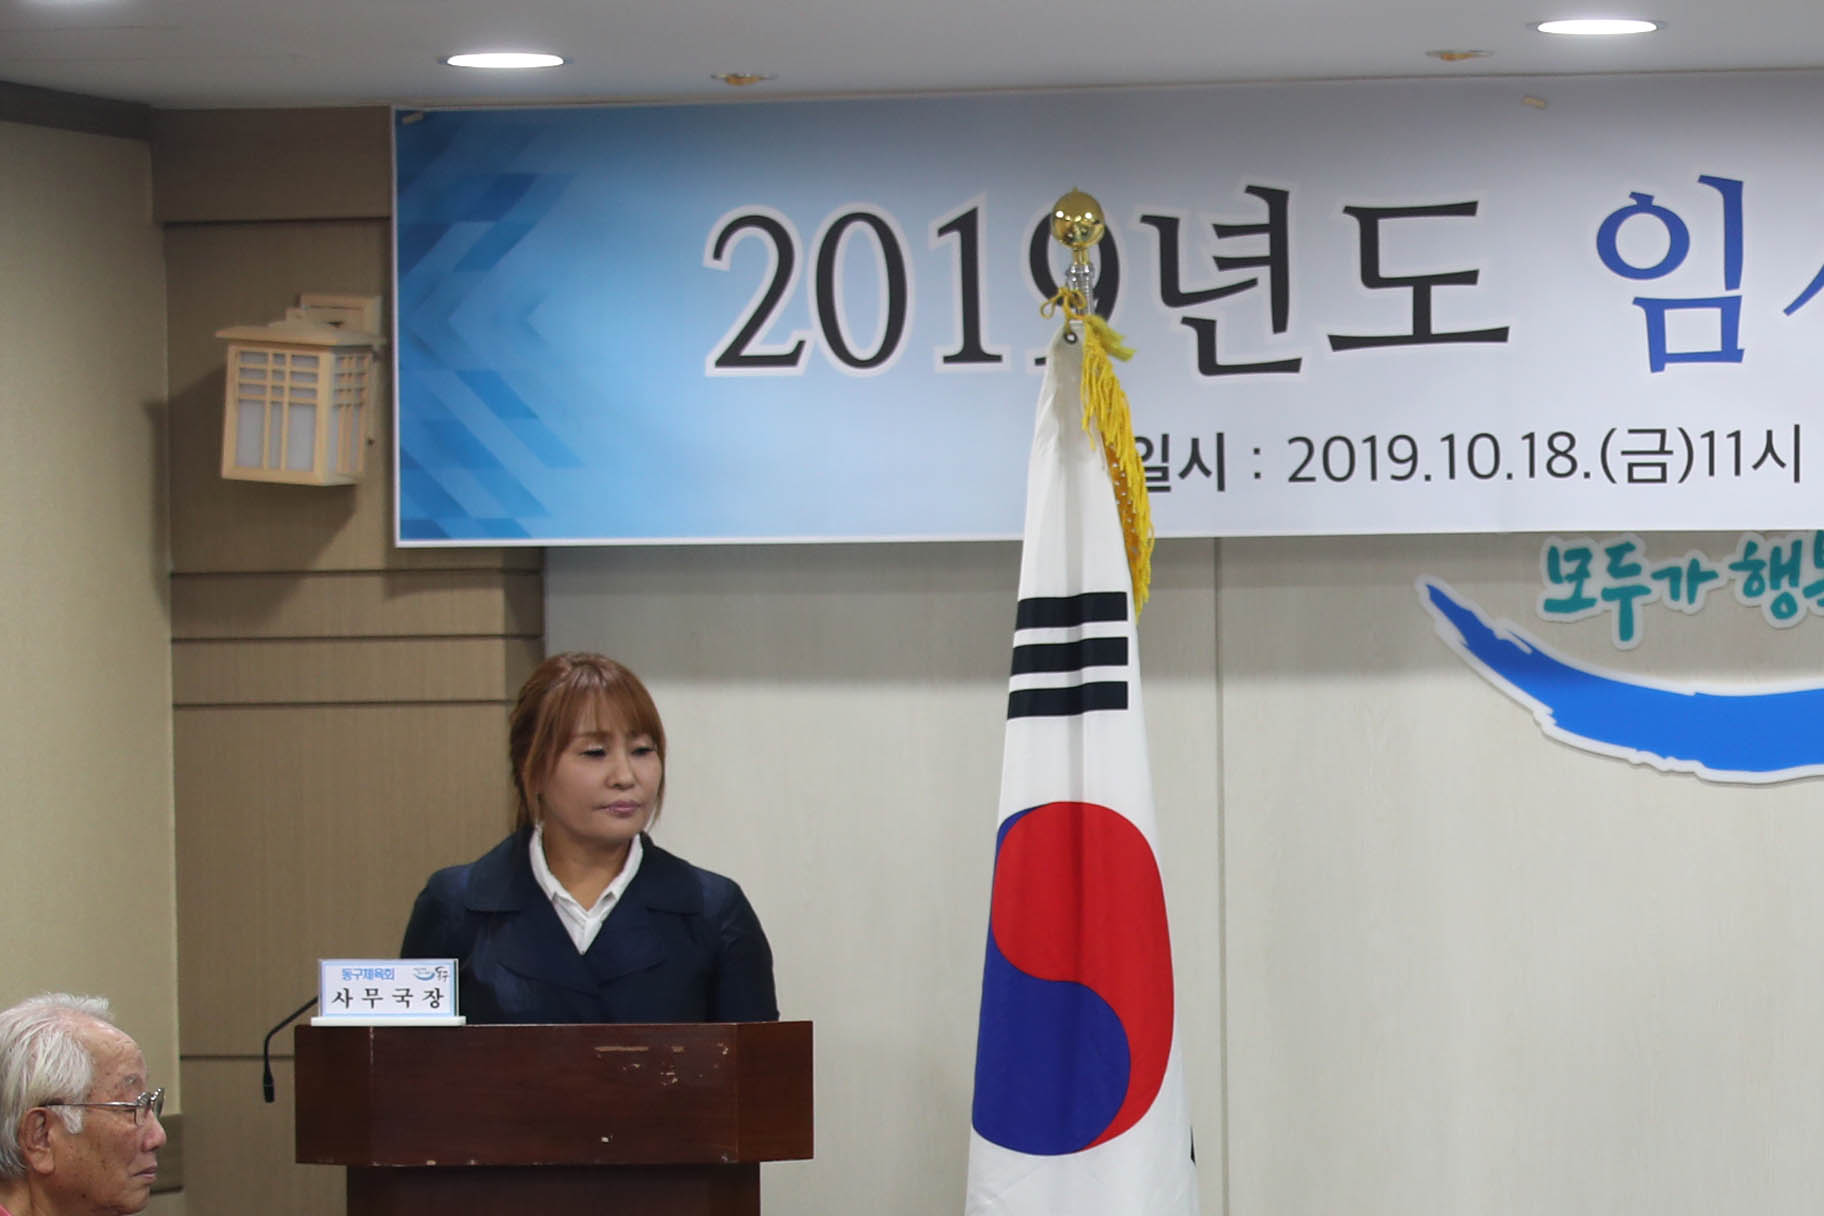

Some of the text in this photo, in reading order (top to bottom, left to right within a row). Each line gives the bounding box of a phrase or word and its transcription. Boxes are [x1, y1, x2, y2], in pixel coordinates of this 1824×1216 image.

[712, 184, 1511, 377] 2019년도
[1135, 432, 1225, 492] 일시
[1287, 424, 1802, 485] 2019.10.18.(금)11시
[1543, 541, 1720, 643] 모두가
[341, 967, 396, 981] 동구체육회
